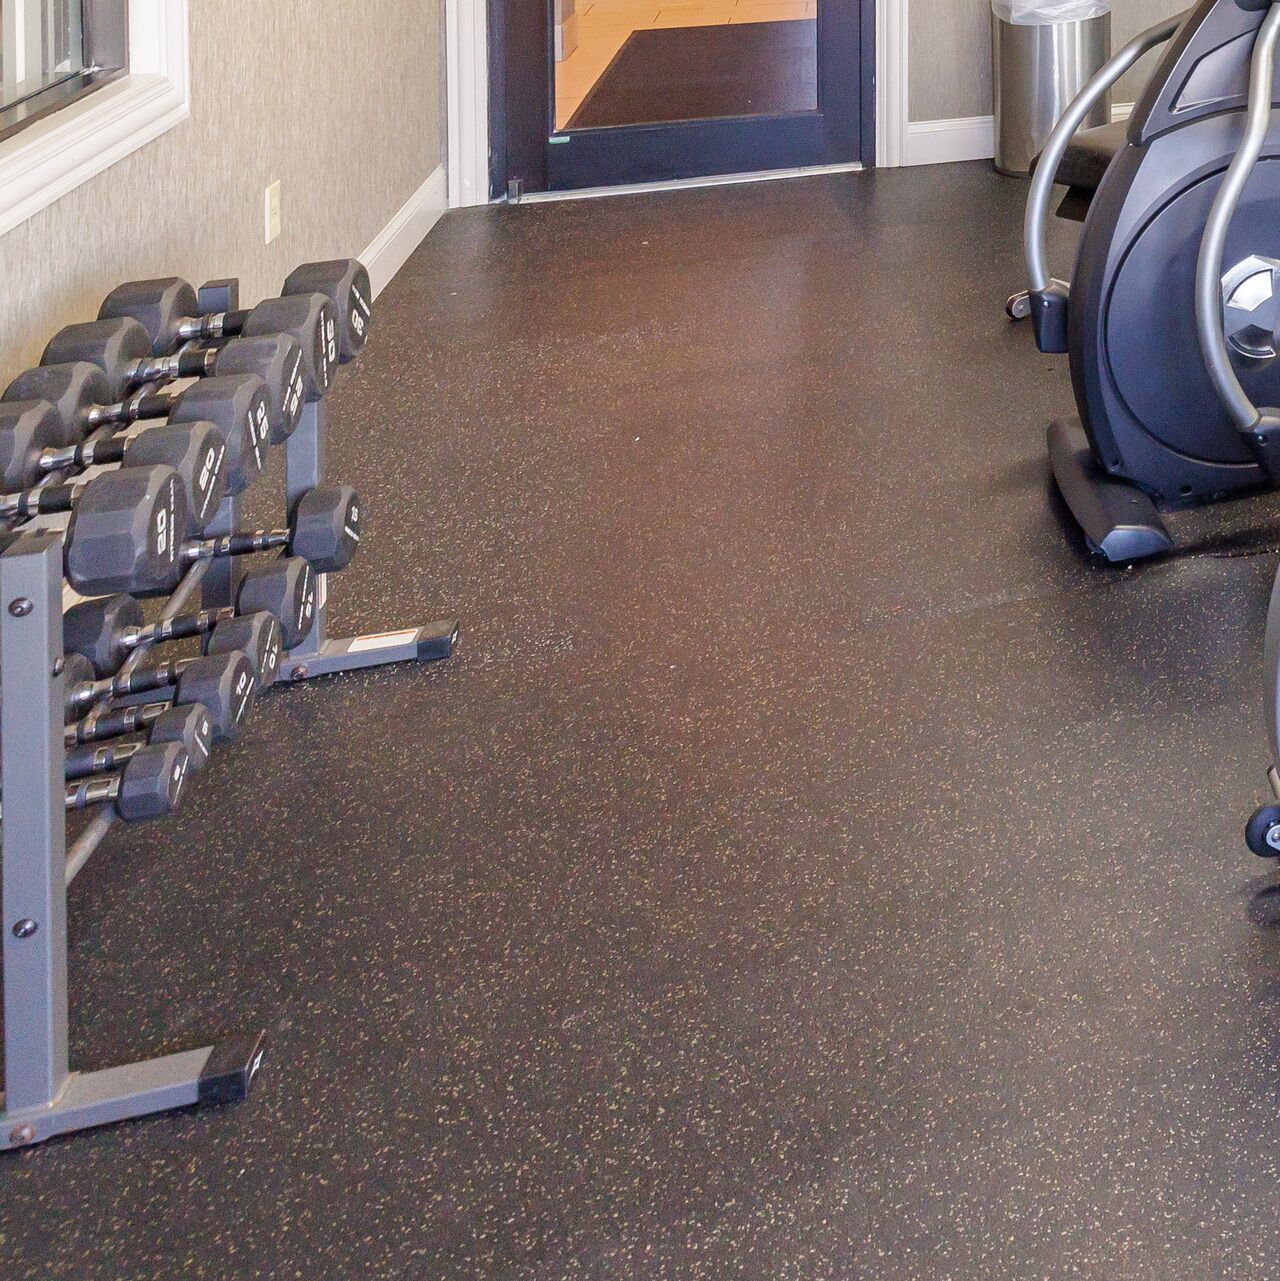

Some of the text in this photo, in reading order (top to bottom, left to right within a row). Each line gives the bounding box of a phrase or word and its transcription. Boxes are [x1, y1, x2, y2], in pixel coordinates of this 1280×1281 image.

[256, 400, 269, 440] 25
[199, 447, 215, 491] 20
[156, 508, 167, 556] 20
[236, 671, 247, 696] 10
